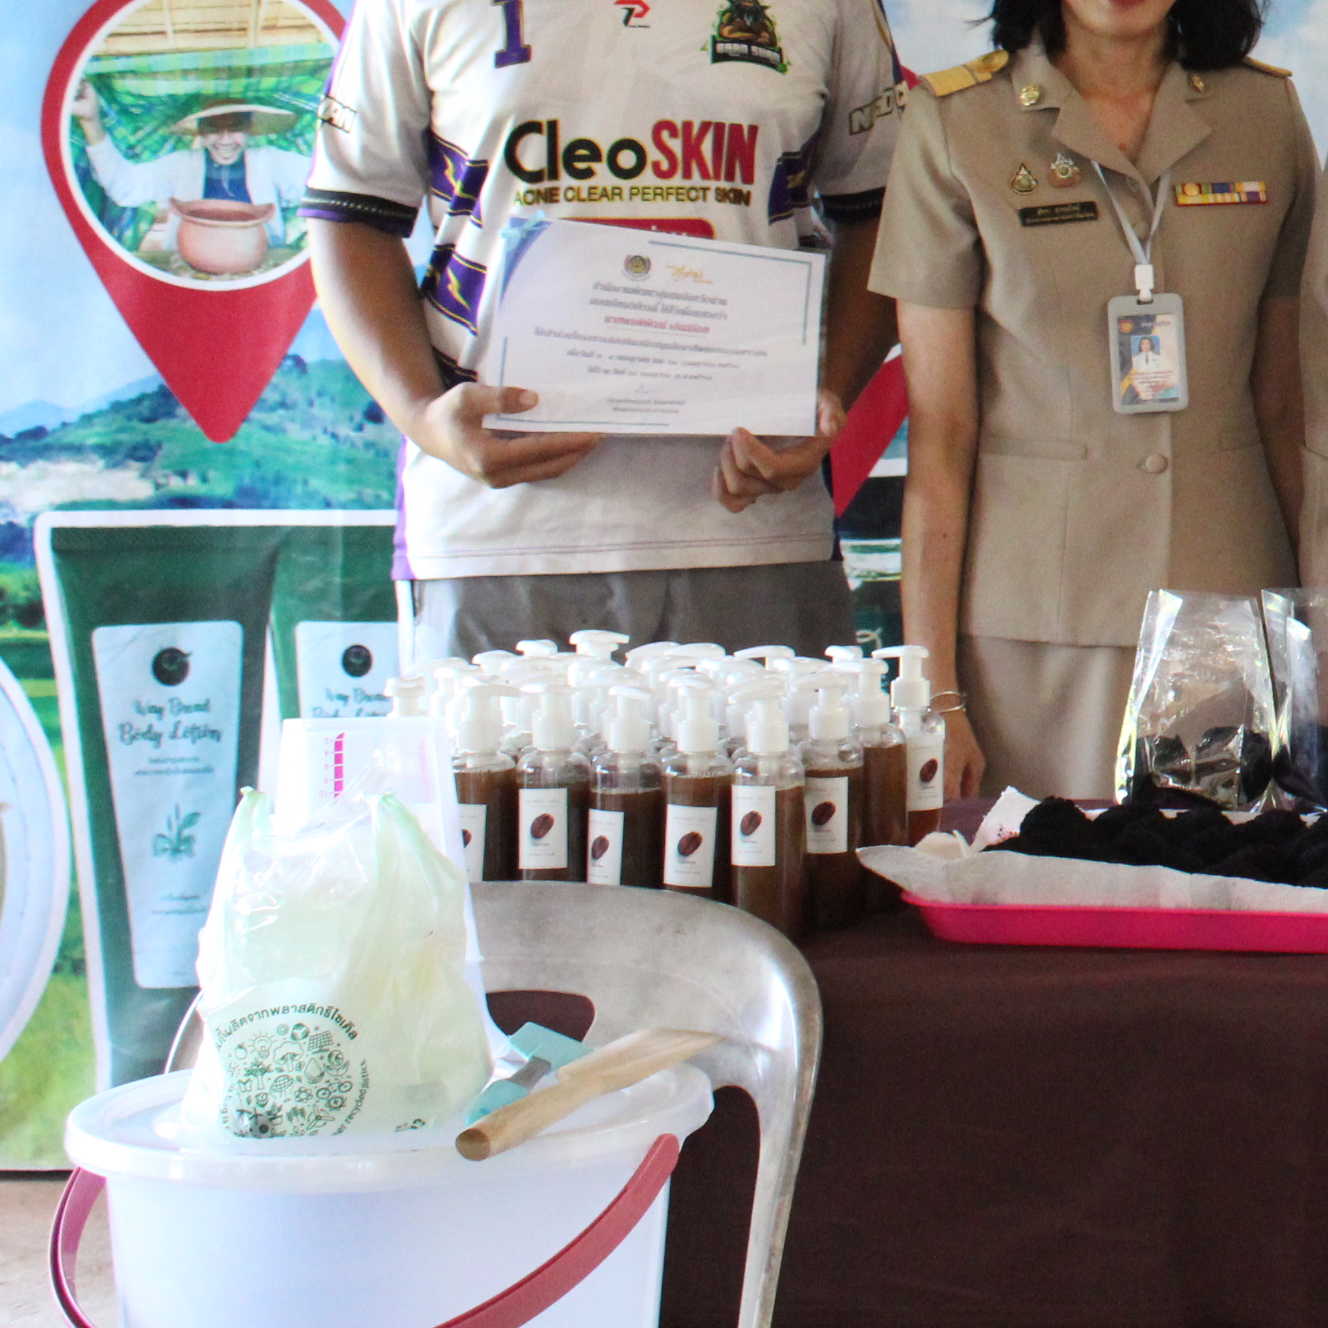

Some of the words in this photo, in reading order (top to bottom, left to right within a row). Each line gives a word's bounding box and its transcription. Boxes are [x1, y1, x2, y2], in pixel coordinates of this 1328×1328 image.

[514, 186, 560, 206] ACNE
[563, 186, 624, 203] CLEAR
[629, 186, 711, 204] PERFECT
[714, 187, 752, 207] SKIN
